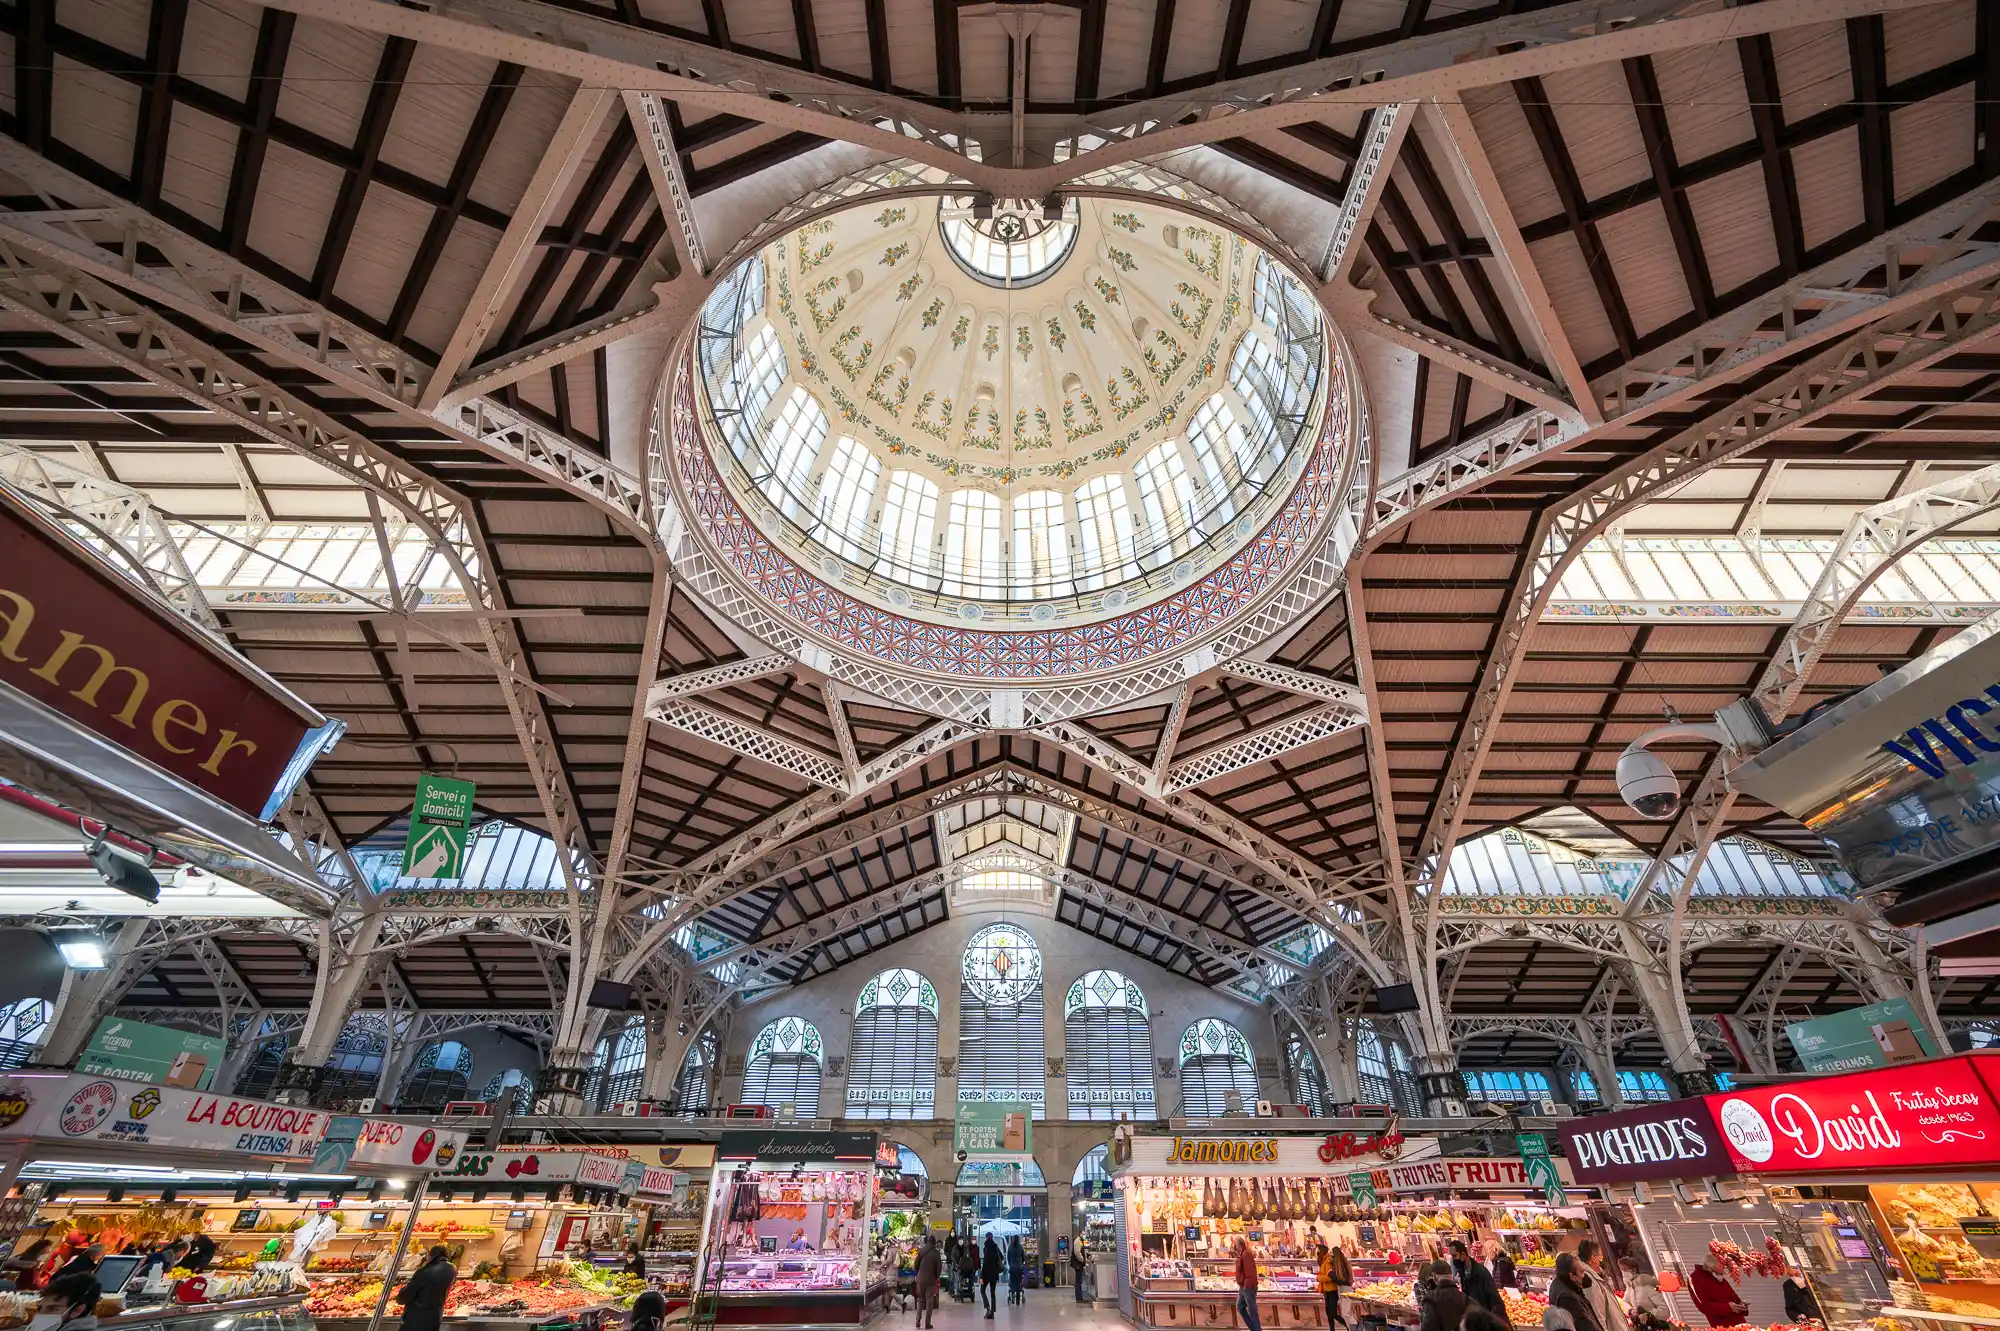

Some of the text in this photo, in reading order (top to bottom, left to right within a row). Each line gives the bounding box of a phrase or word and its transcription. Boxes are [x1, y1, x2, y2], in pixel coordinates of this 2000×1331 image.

[426, 785, 467, 803] Servei a
[422, 800, 465, 818] domicili
[1825, 1055, 1875, 1072] LLEVAMOS
[74, 1084, 114, 1105] BOUTIQUE
[1889, 1086, 1979, 1111] Frutos Secos
[81, 1104, 94, 1115] DEL
[186, 1096, 219, 1125] LA
[221, 1101, 318, 1136] BOUTIQUE
[1919, 1113, 1948, 1125] desde
[63, 1116, 95, 1133] QUESO
[1728, 1122, 1769, 1146] David
[1769, 1089, 1902, 1159] David
[235, 1133, 292, 1154] EXTENSA
[969, 1139, 997, 1149] CASA
[1166, 1136, 1279, 1162] Jamones
[1571, 1117, 1708, 1169] PUCHADES
[581, 1158, 616, 1182] VIRGINIA
[1393, 1162, 1447, 1187] FRUTAS
